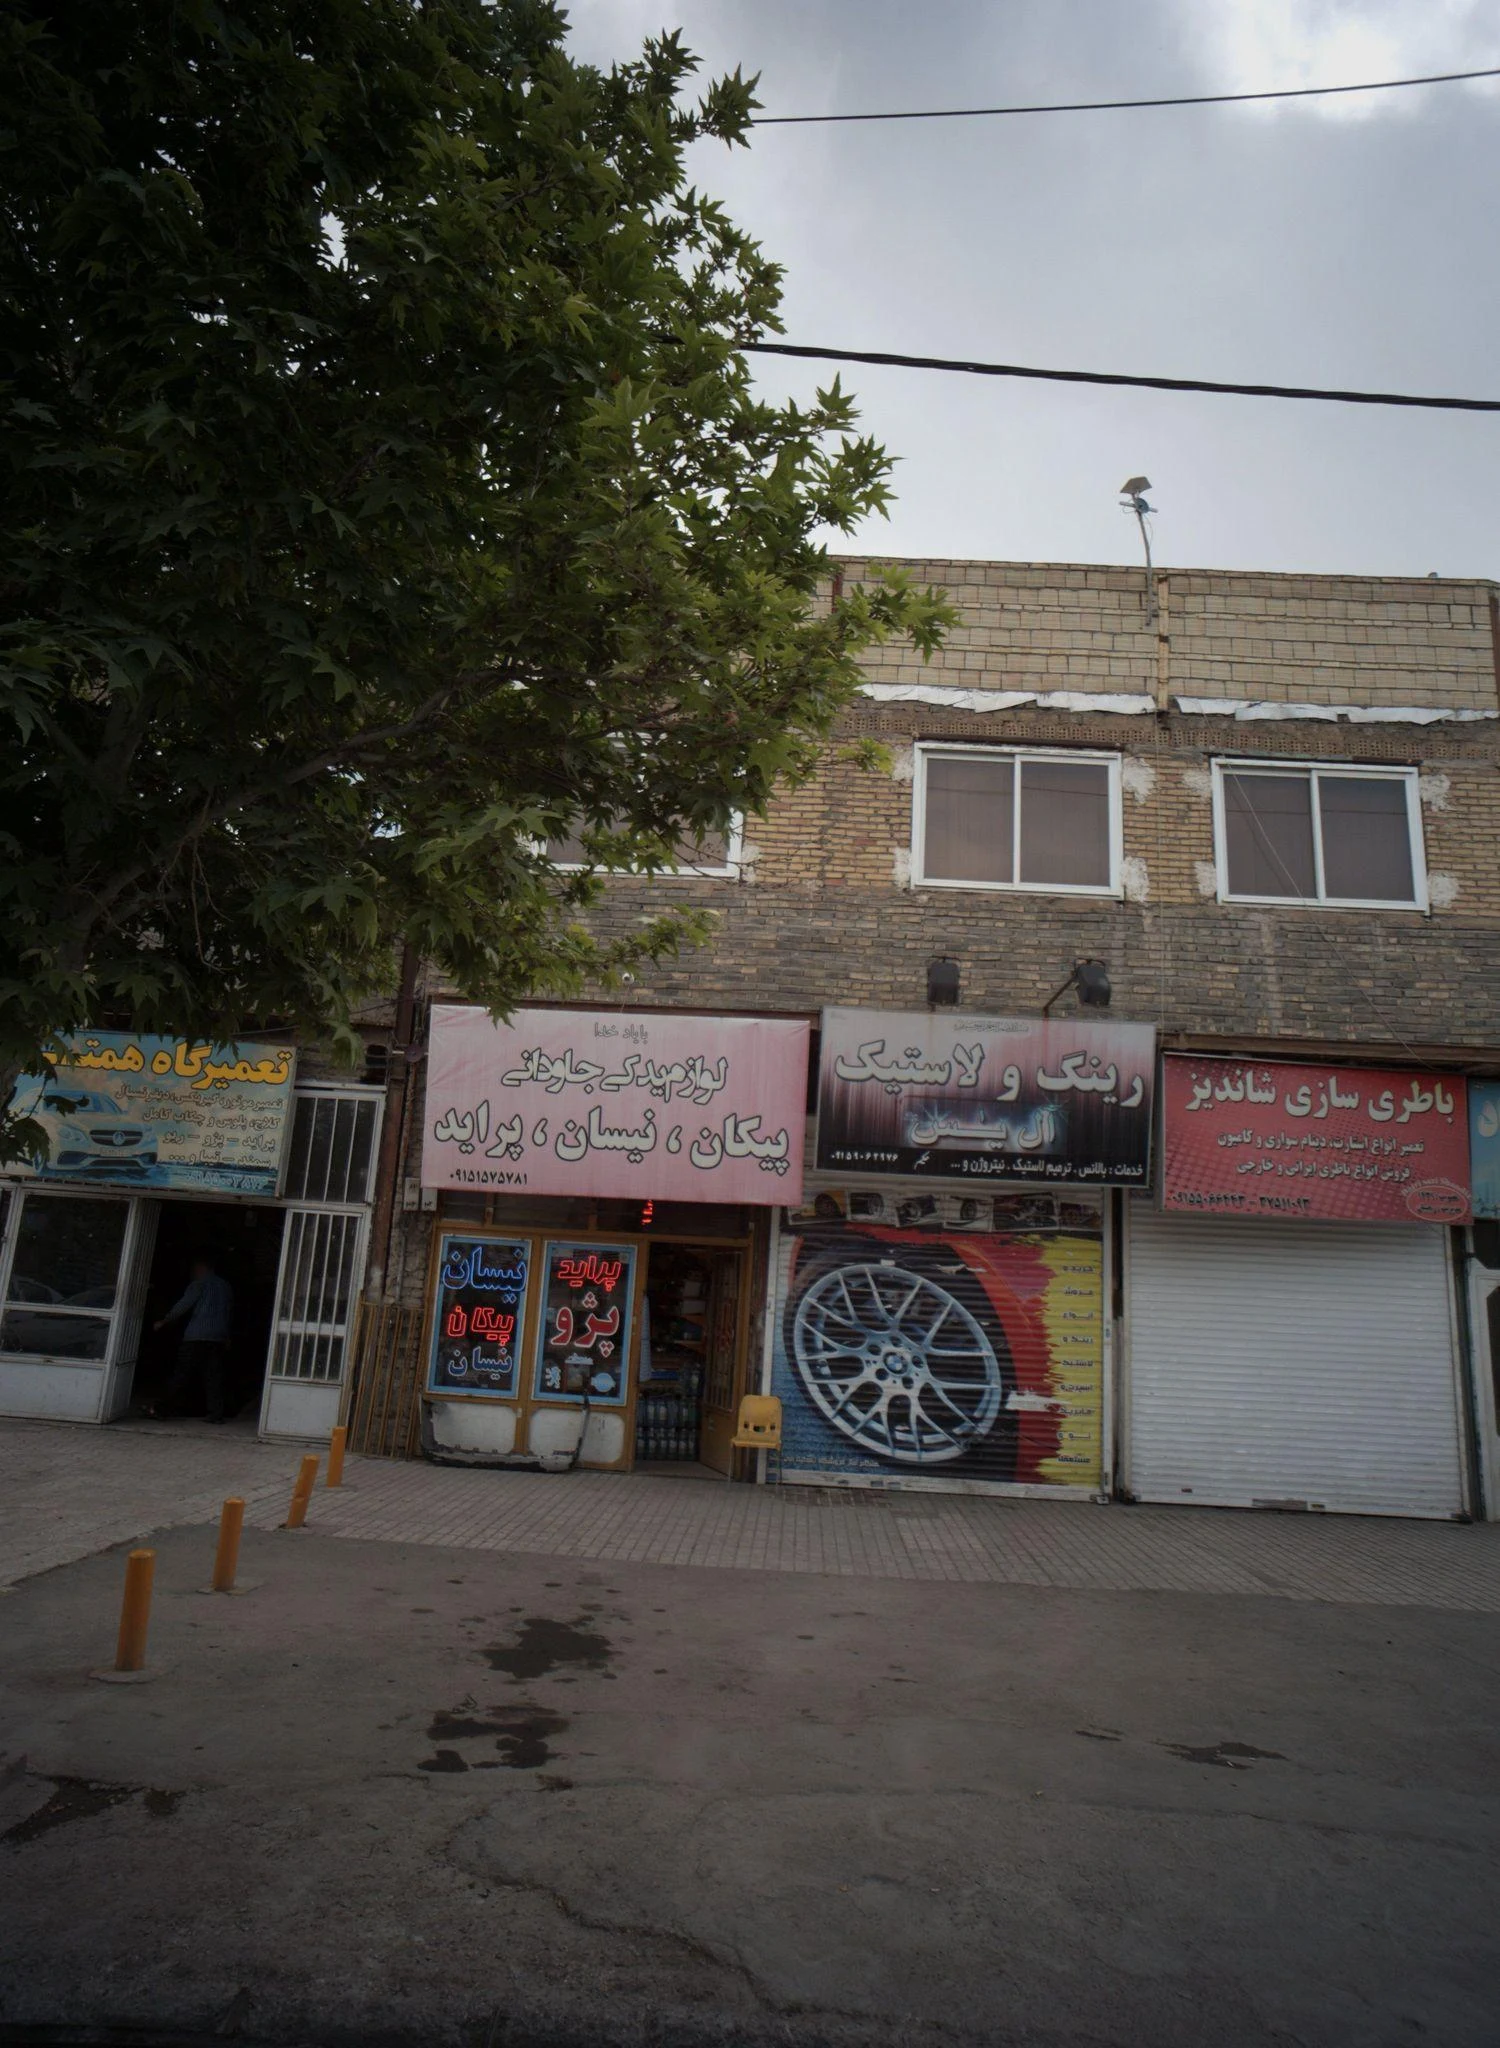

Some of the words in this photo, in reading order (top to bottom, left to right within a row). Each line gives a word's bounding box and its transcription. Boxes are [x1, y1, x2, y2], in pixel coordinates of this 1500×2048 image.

[594, 1021, 619, 1038] خدا
[151, 1042, 293, 1089] تعمیرگاه
[835, 1038, 986, 1095] لاستیک
[996, 1063, 1021, 1101] و
[1036, 1050, 1145, 1108] رینگ
[1185, 1066, 1277, 1111] شاندیز
[1284, 1075, 1359, 1118] سازی
[1368, 1079, 1454, 1123] باطری
[242, 1134, 276, 1152] پراید
[434, 1100, 524, 1161] پراید
[555, 1105, 658, 1164] نیسان
[689, 1112, 790, 1176] پیکان
[1256, 1136, 1262, 1149] و
[1264, 1131, 1298, 1150] سواری
[1370, 1138, 1397, 1155] انواع
[449, 1167, 528, 1185] ۰۹۱۵۱۵۷۵۷۸۱
[962, 1159, 969, 1172] و
[1012, 1157, 1045, 1174] لاستیک
[1114, 1163, 1143, 1177] خدمات
[1236, 1155, 1274, 1174] خارجی
[1277, 1164, 1283, 1176] و
[442, 1245, 528, 1304] نیسان
[557, 1255, 623, 1292] پراید
[446, 1305, 514, 1347] پیکان
[550, 1291, 620, 1358] پژو
[448, 1346, 513, 1380] نیسان
